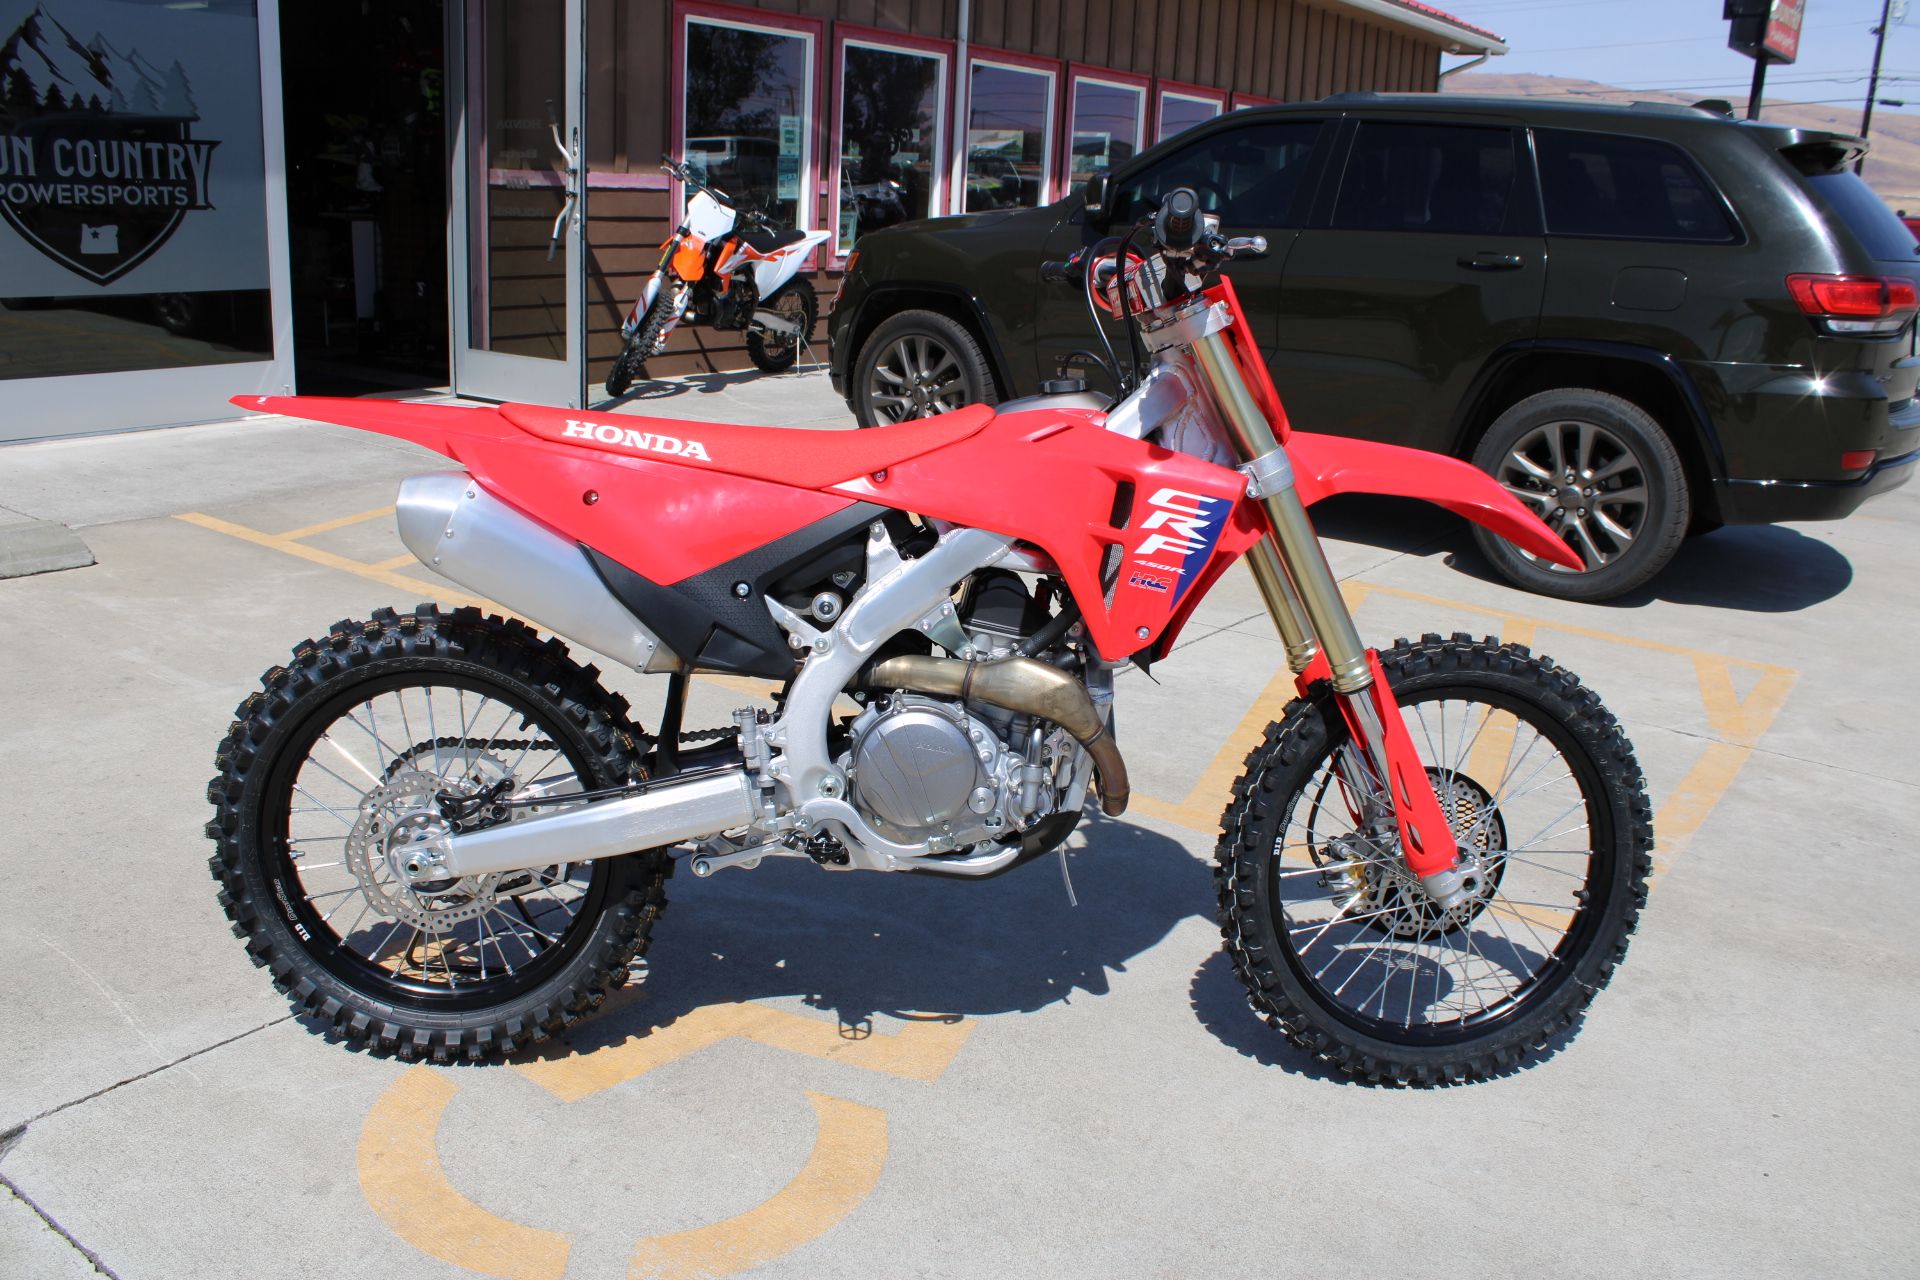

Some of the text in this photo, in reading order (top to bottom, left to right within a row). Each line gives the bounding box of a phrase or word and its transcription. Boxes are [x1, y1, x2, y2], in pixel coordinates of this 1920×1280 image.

[53, 137, 210, 206] COUNTRY
[562, 419, 711, 462] HONDA
[1133, 487, 1219, 556] CRF
[1129, 571, 1172, 591] HRC
